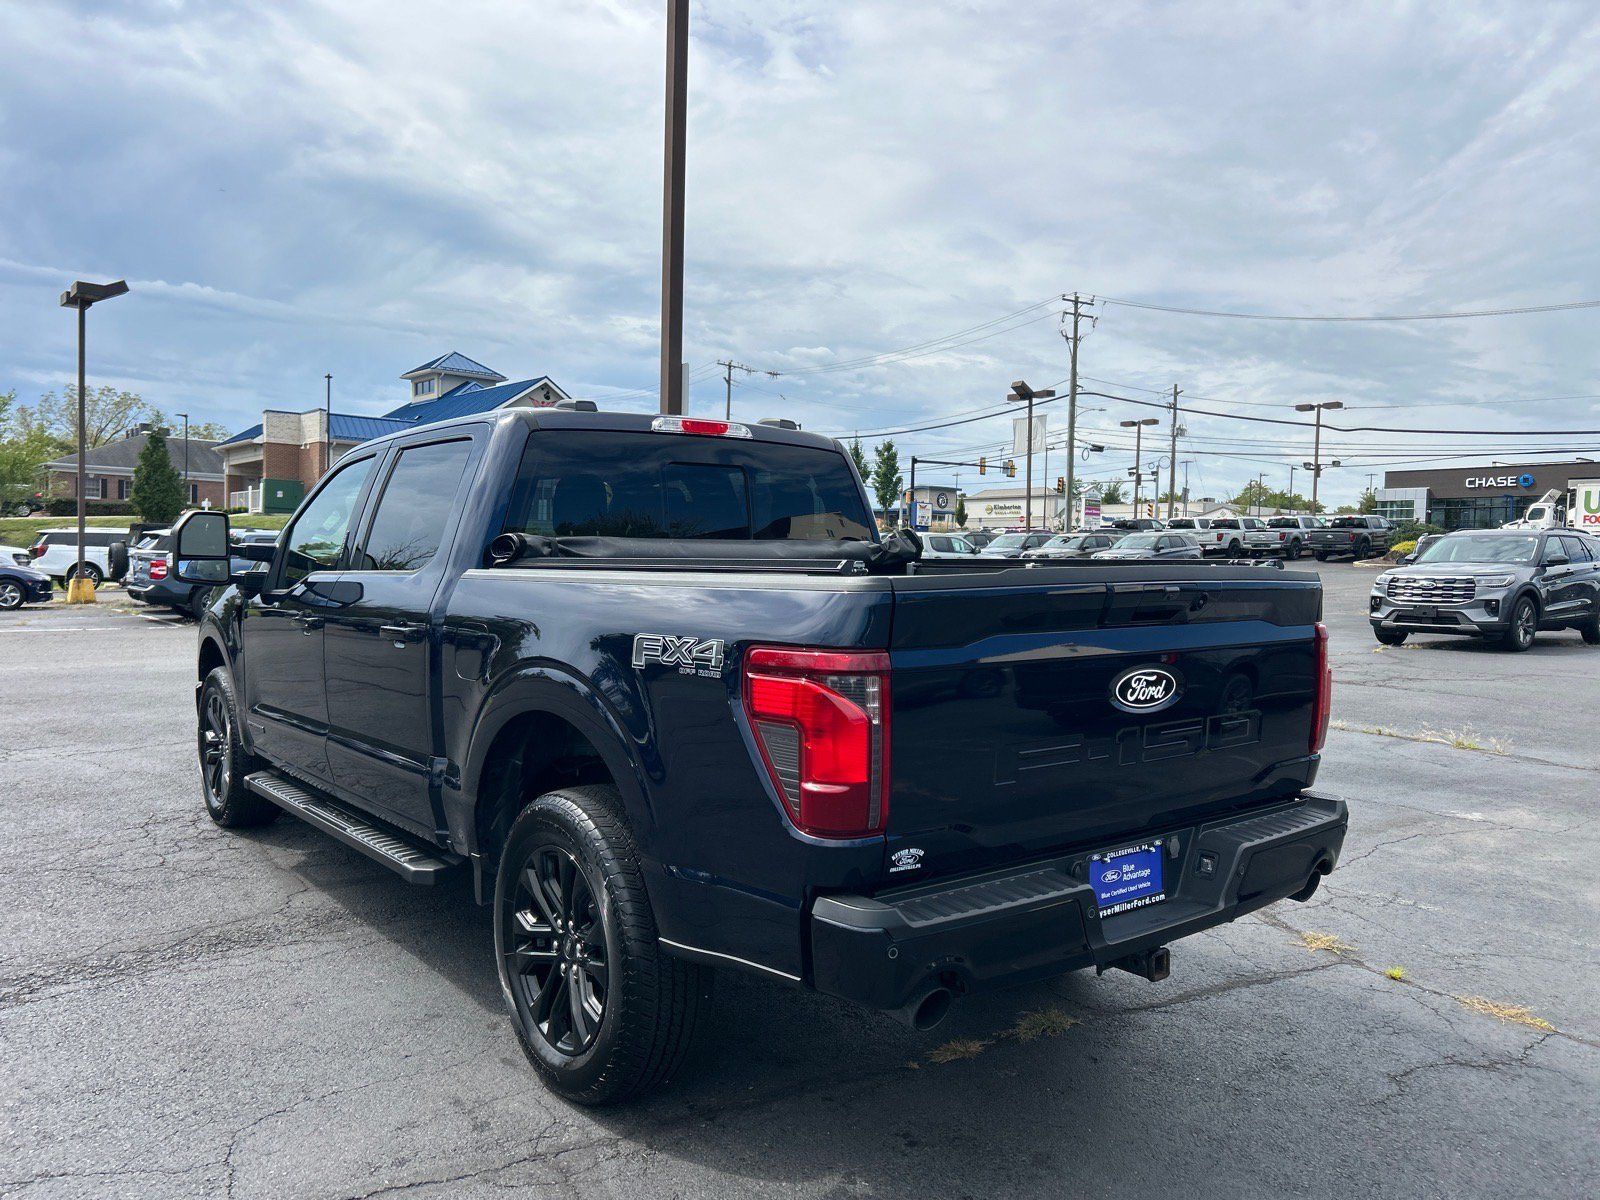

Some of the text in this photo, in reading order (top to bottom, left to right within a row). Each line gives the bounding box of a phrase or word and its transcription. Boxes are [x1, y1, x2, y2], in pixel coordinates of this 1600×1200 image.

[1465, 476, 1518, 488] CHASE
[632, 633, 725, 671] FX4
[1126, 675, 1166, 701] Ford
[1122, 864, 1135, 873] Blue
[1122, 868, 1151, 882] Advantage
[1101, 891, 1111, 899] Blue
[1111, 887, 1128, 897] Certified
[1138, 881, 1151, 890] Vehicle
[1099, 893, 1166, 919] yserMillerFord.com
